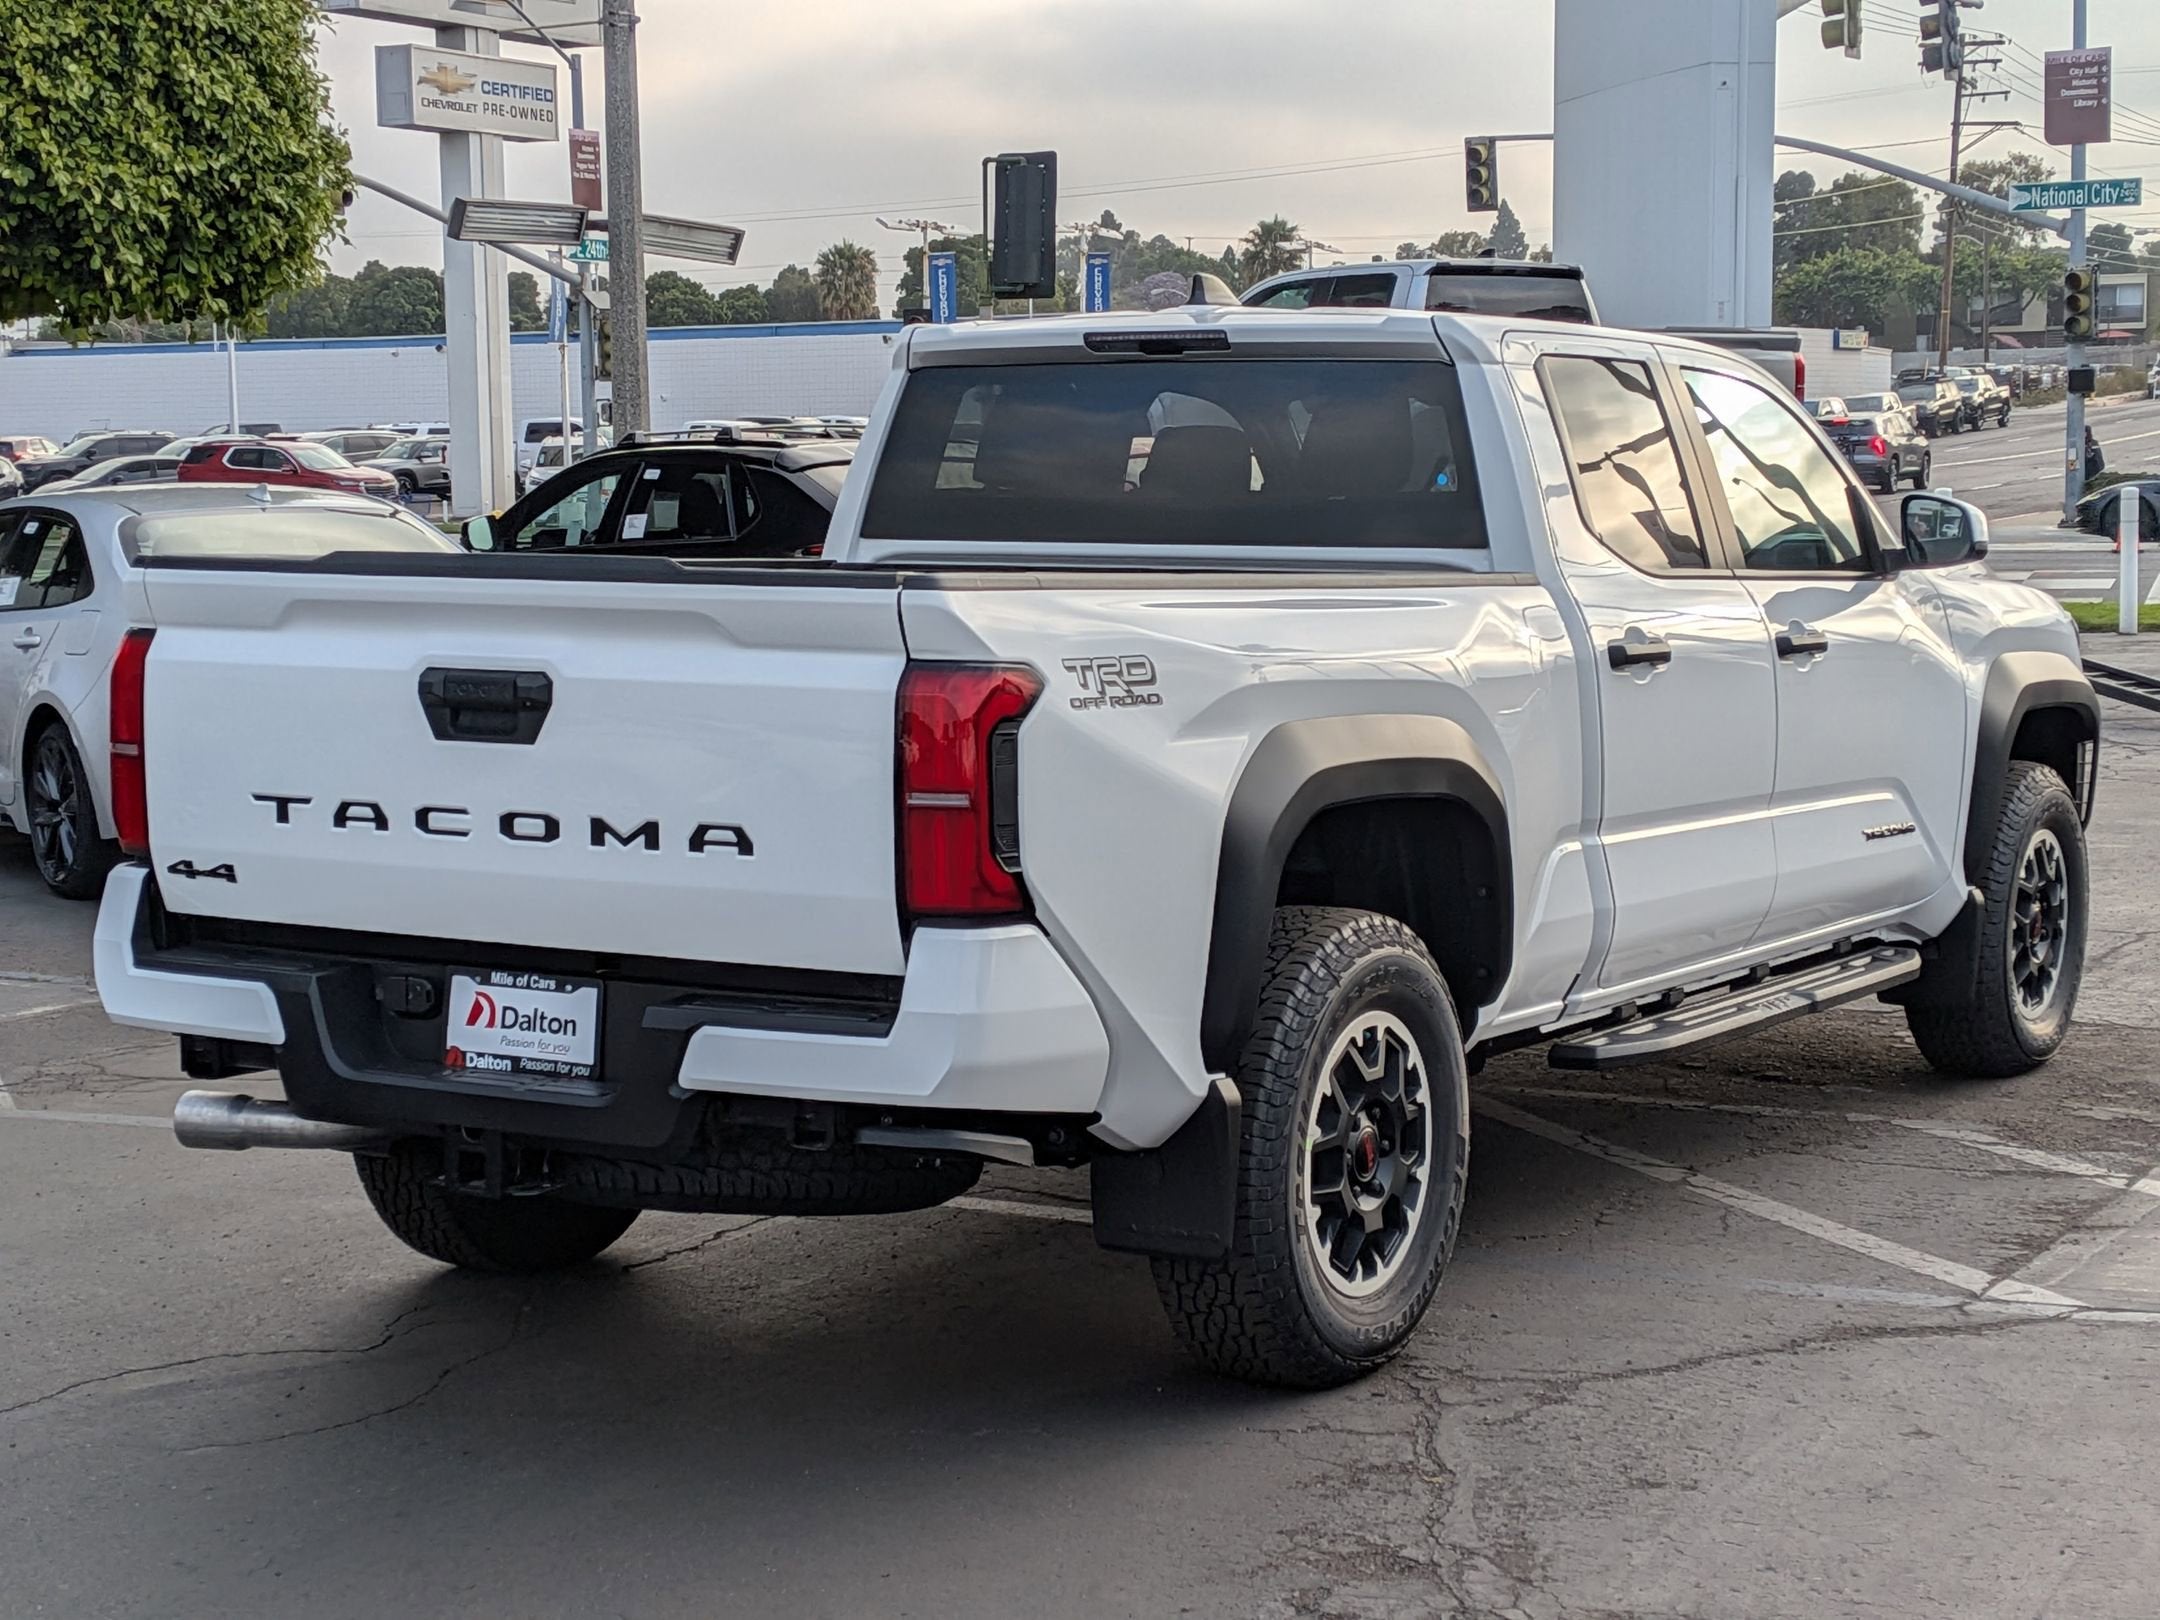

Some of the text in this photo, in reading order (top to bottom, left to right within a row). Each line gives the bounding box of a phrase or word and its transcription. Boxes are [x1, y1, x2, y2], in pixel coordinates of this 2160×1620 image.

[2069, 67, 2083, 77] City
[481, 80, 554, 103] CERTIFIED
[421, 97, 478, 114] CHEVROLET
[483, 101, 554, 123] PRE-OWNED
[2031, 184, 2088, 208] National
[2091, 182, 2120, 205] City
[585, 240, 606, 259] 24th
[1061, 654, 1157, 697] TRD
[1069, 692, 1164, 711] OFF ROAD
[250, 792, 755, 858] TACOMA
[490, 971, 556, 990] Mile of Cars
[500, 1005, 577, 1037] Dalton
[499, 1035, 571, 1053] Passion for you
[465, 1053, 591, 1077] Dalton Passion for you
